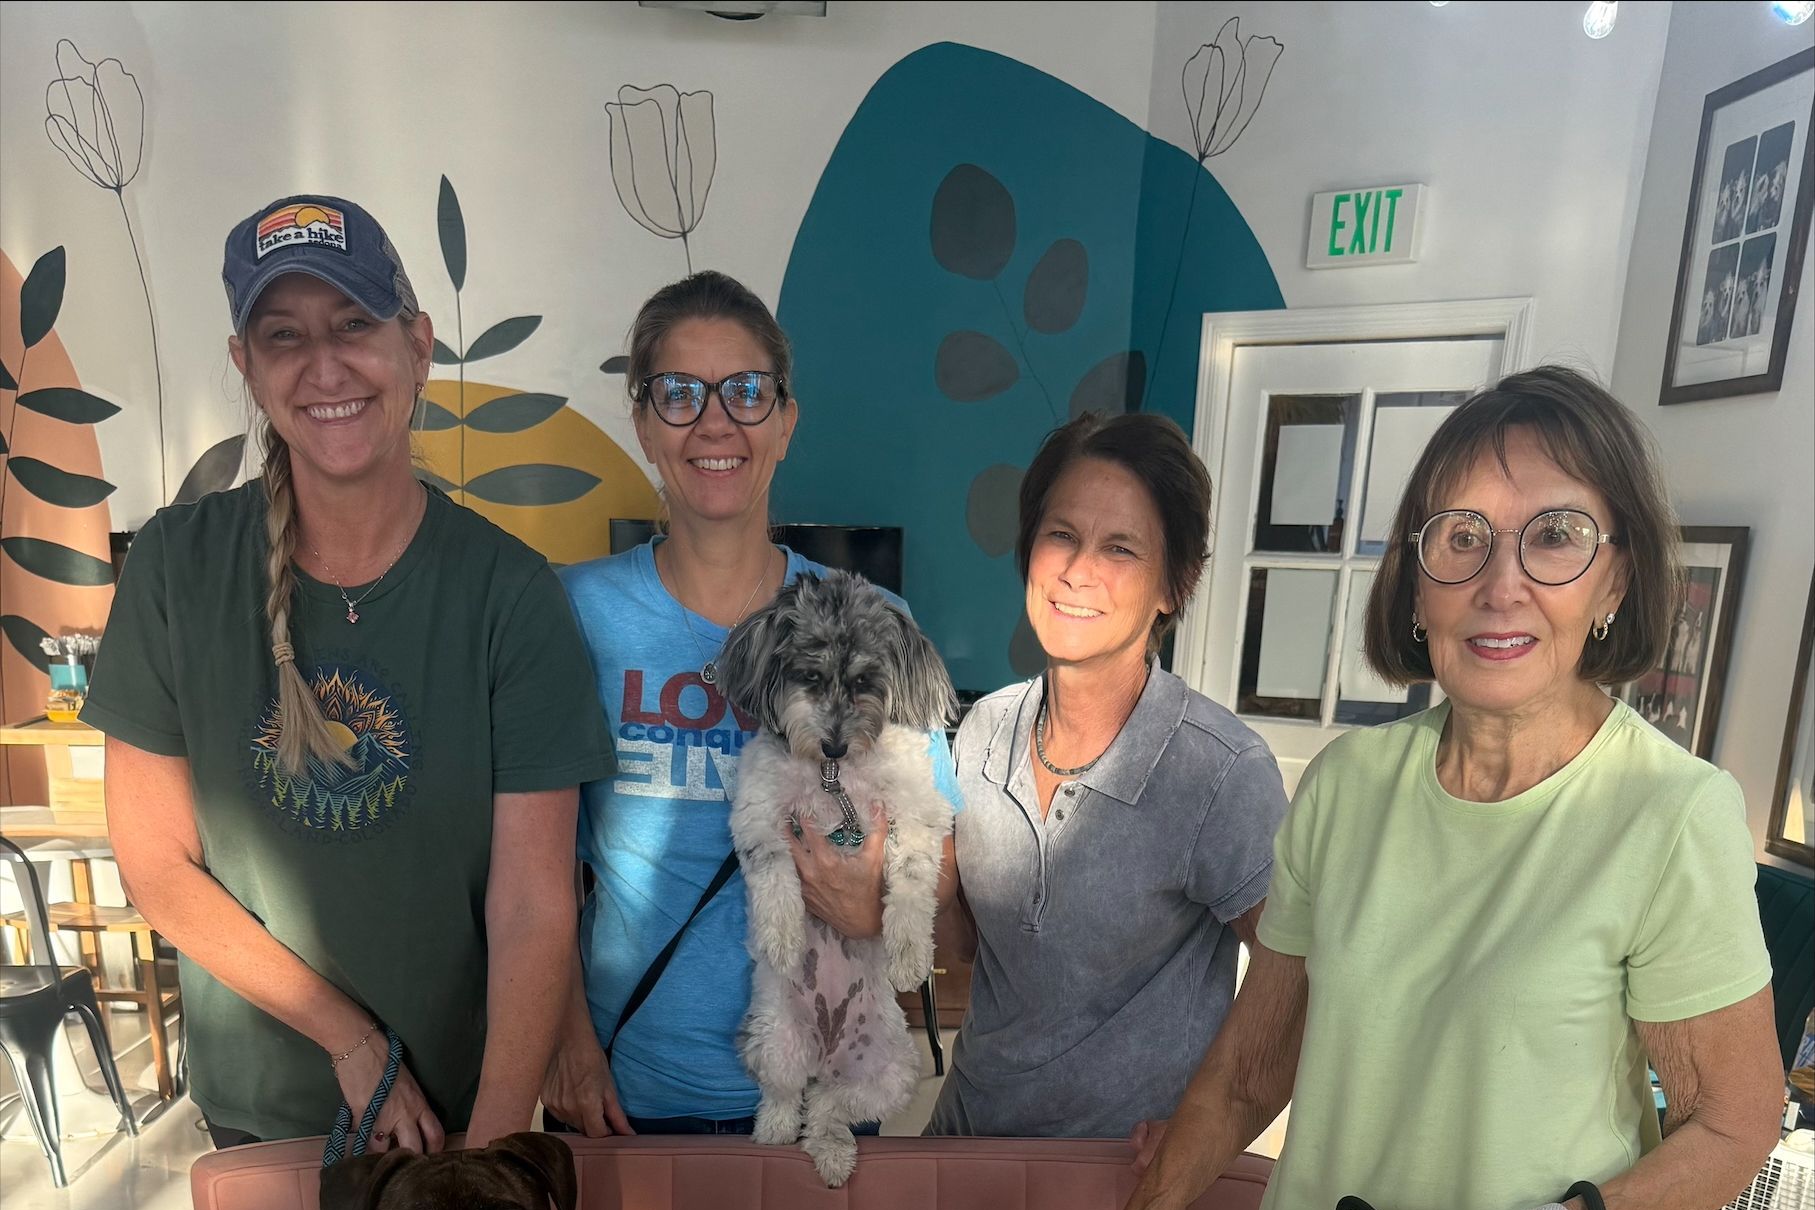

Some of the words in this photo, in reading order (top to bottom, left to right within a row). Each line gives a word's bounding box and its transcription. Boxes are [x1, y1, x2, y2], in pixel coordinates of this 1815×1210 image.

[259, 231, 291, 251] take
[294, 231, 304, 239] a
[307, 227, 344, 243] hike
[1328, 189, 1403, 256] EXIT
[621, 669, 761, 731] LO
